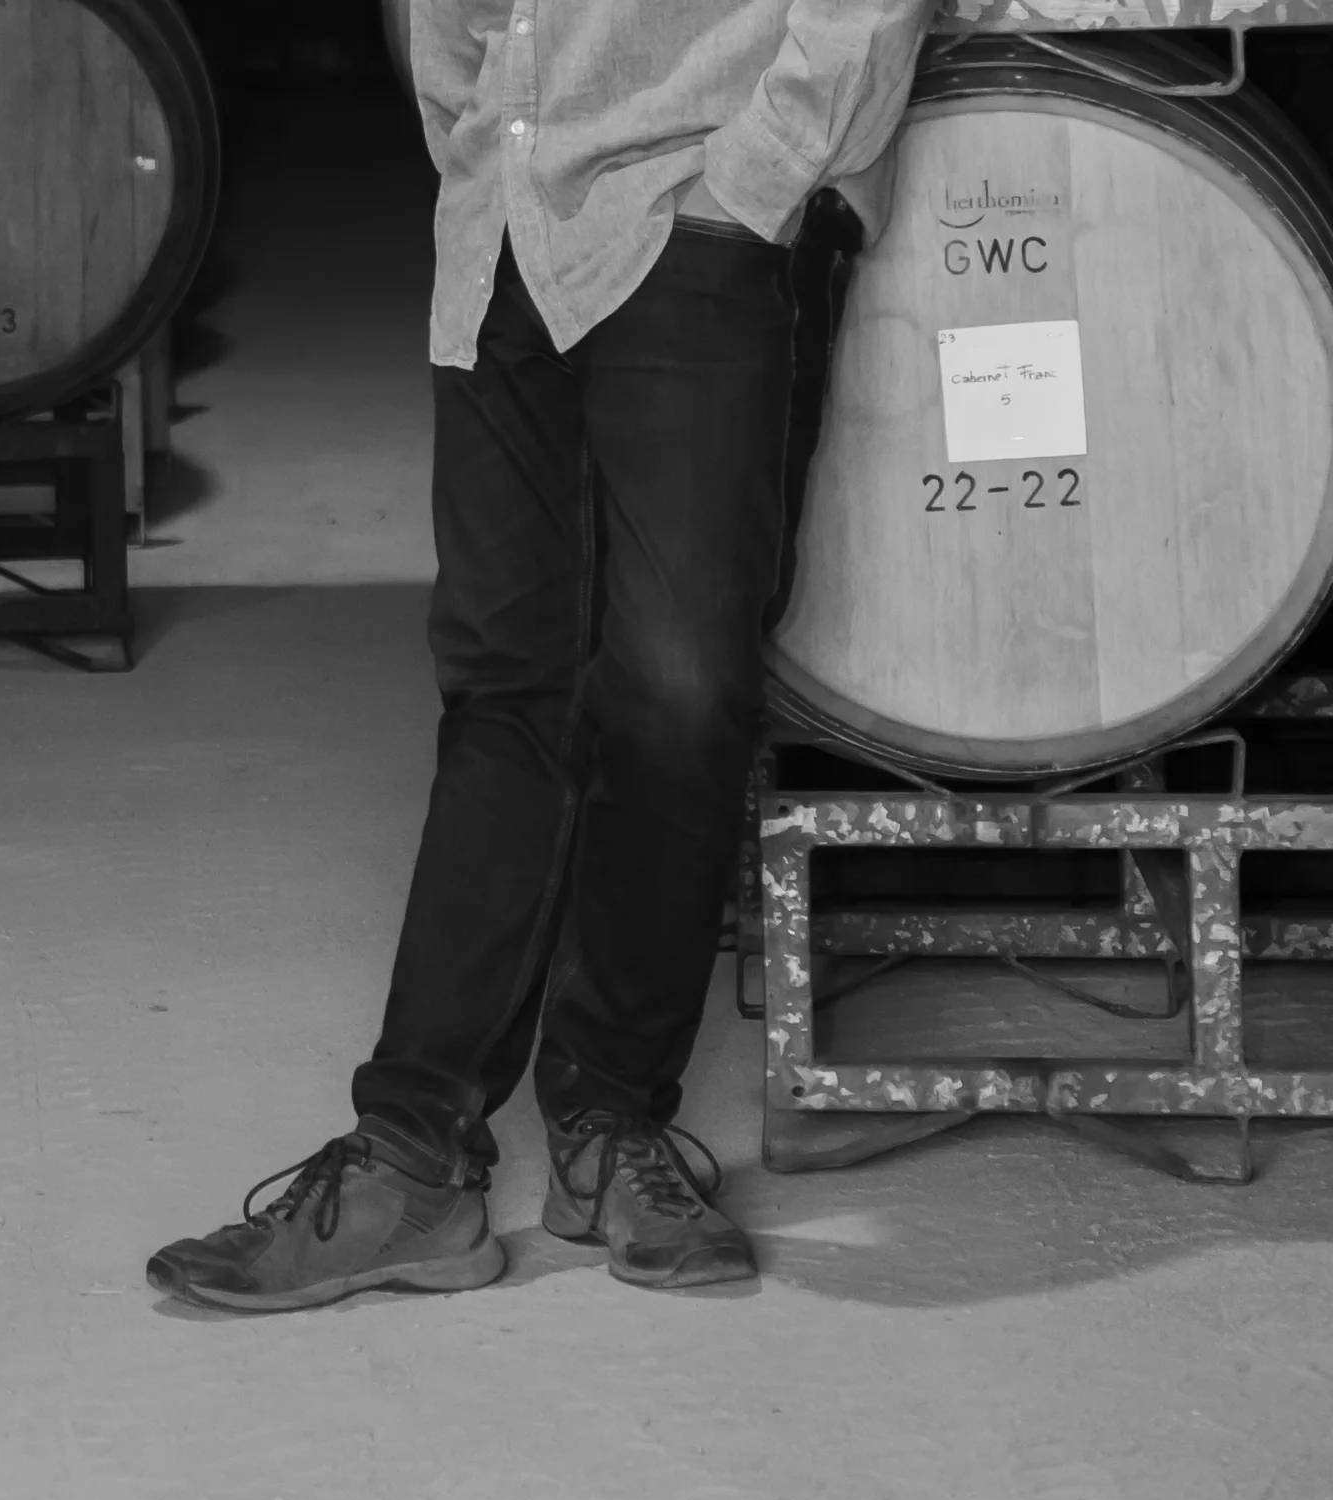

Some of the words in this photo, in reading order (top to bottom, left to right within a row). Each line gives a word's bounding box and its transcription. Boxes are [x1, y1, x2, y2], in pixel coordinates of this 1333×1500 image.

[944, 235, 1048, 276] GWC
[1000, 393, 1012, 406] 5
[922, 468, 1081, 512] 22-22
